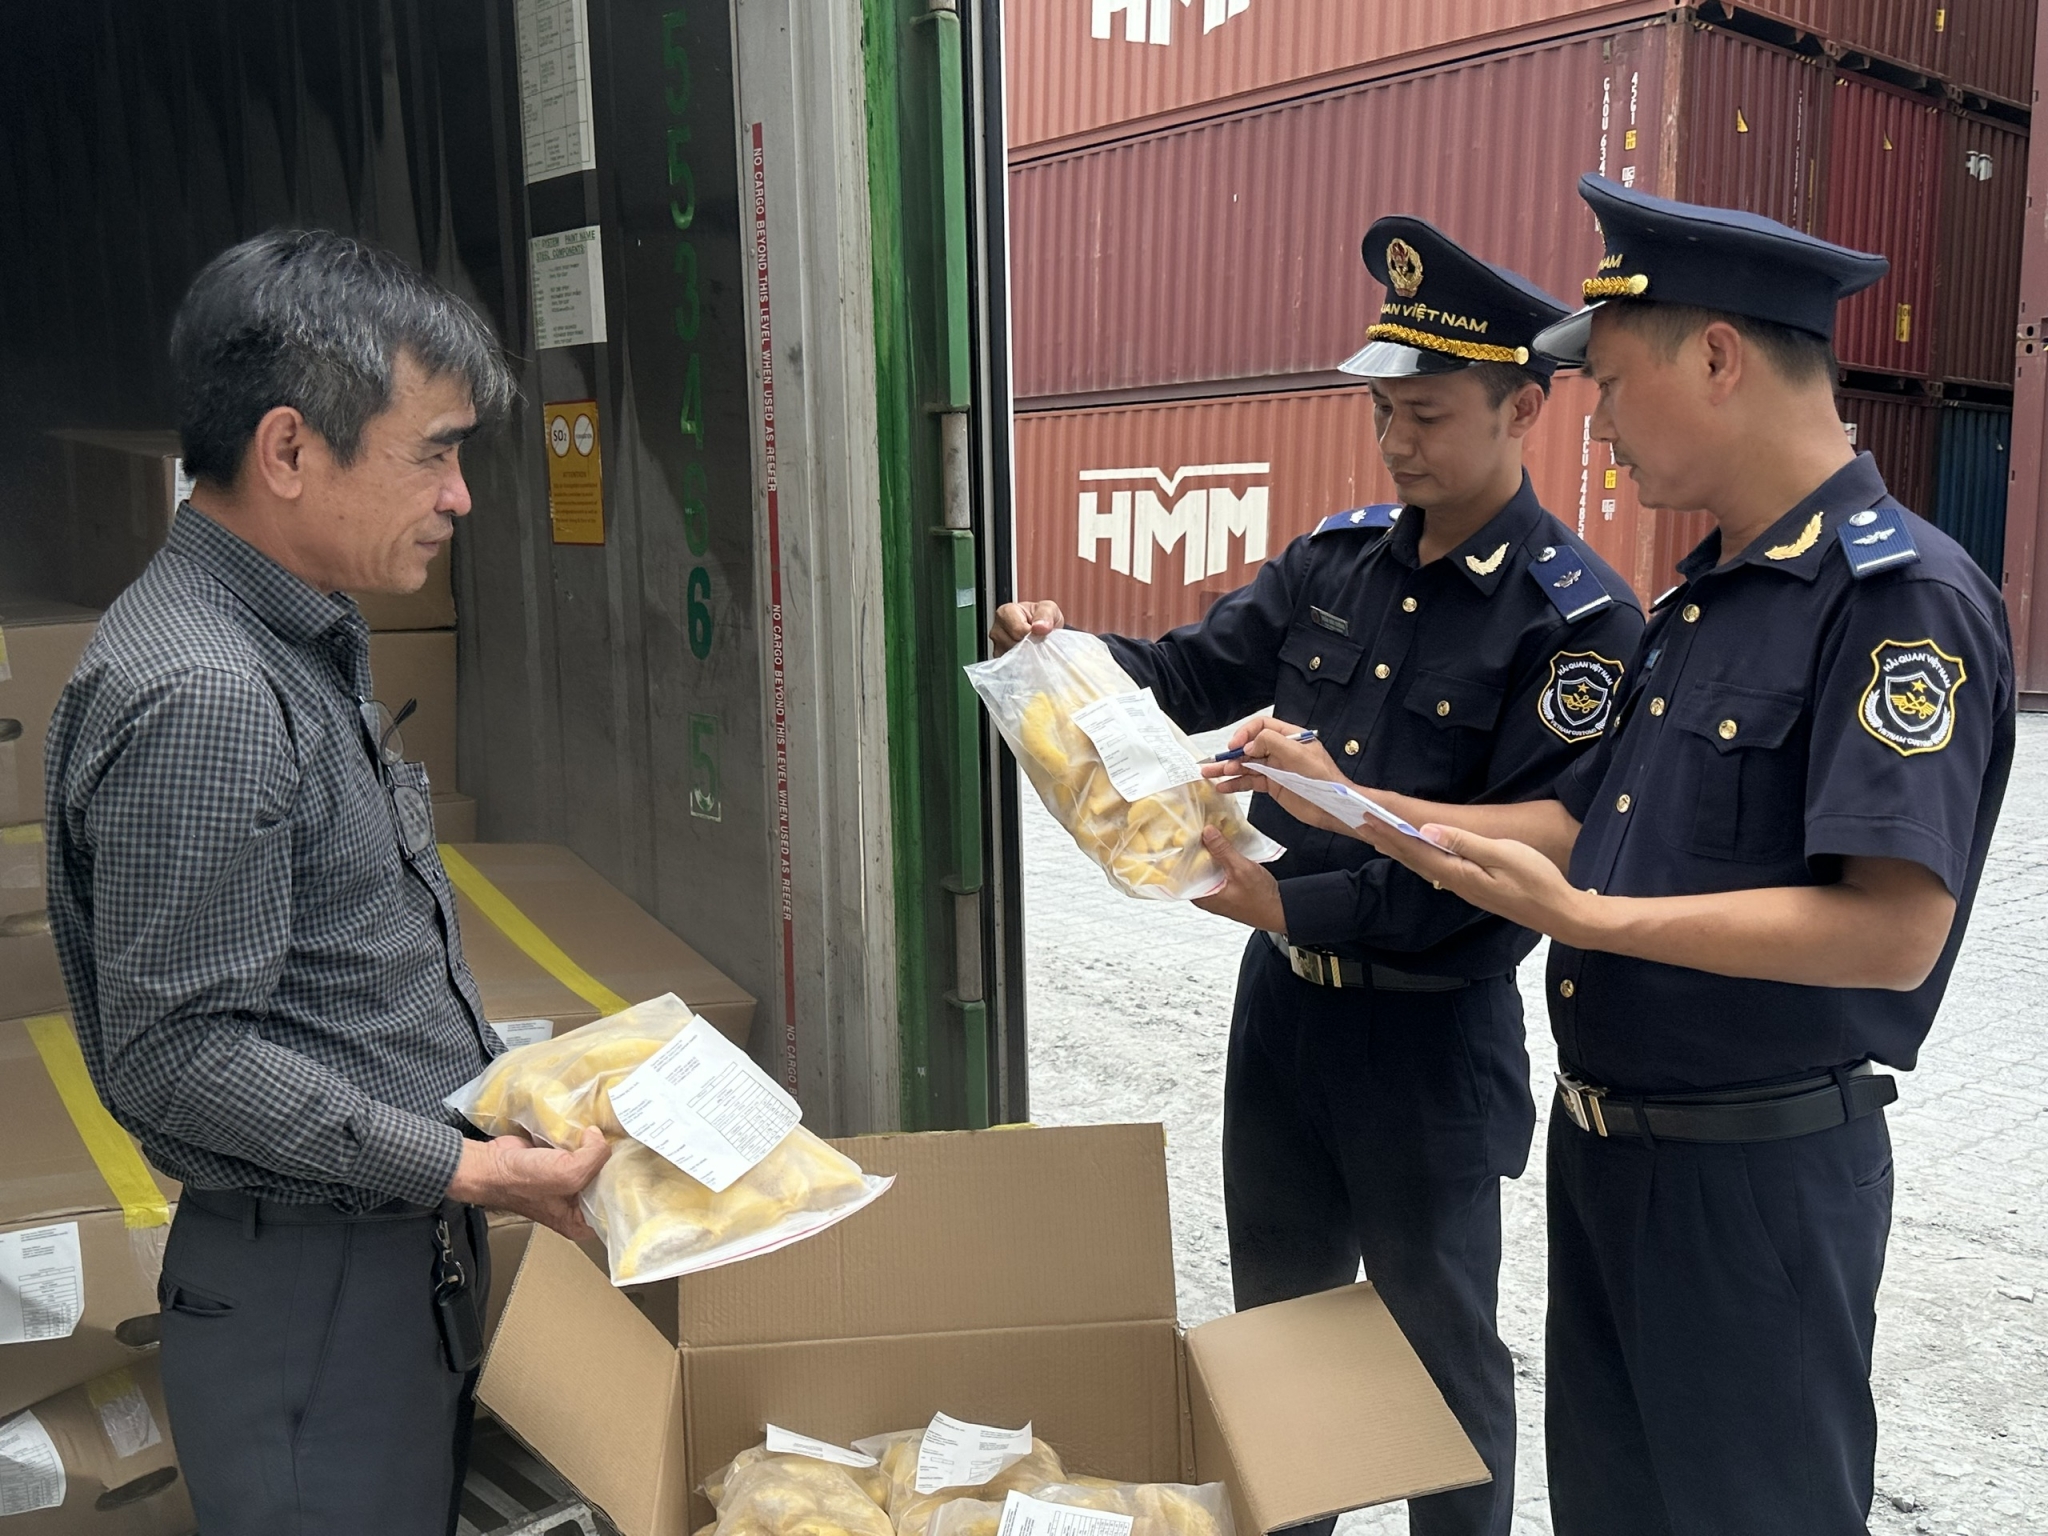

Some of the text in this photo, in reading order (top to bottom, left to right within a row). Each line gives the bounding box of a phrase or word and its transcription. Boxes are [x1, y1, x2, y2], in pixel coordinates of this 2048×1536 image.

[1601, 77, 1611, 131] GAOU
[753, 147, 777, 492] NO CARGO BEYOND THIS LEVEL WHEN USED AS REEFER
[1402, 302, 1440, 323] VIỆT
[1441, 311, 1489, 334] NAM
[1581, 415, 1592, 467] KOCU
[1078, 486, 1269, 586] HMM
[1568, 660, 1588, 670] QUAN
[1898, 652, 1926, 664] QUAN
[1926, 653, 1942, 670] VIỆT
[1938, 667, 1952, 689] NAM
[772, 604, 792, 921] NO CARGO BEYOND THIS LEVEL WHEN USED AS REEFER
[786, 1024, 796, 1041] NO
[787, 1044, 797, 1084] CARGO
